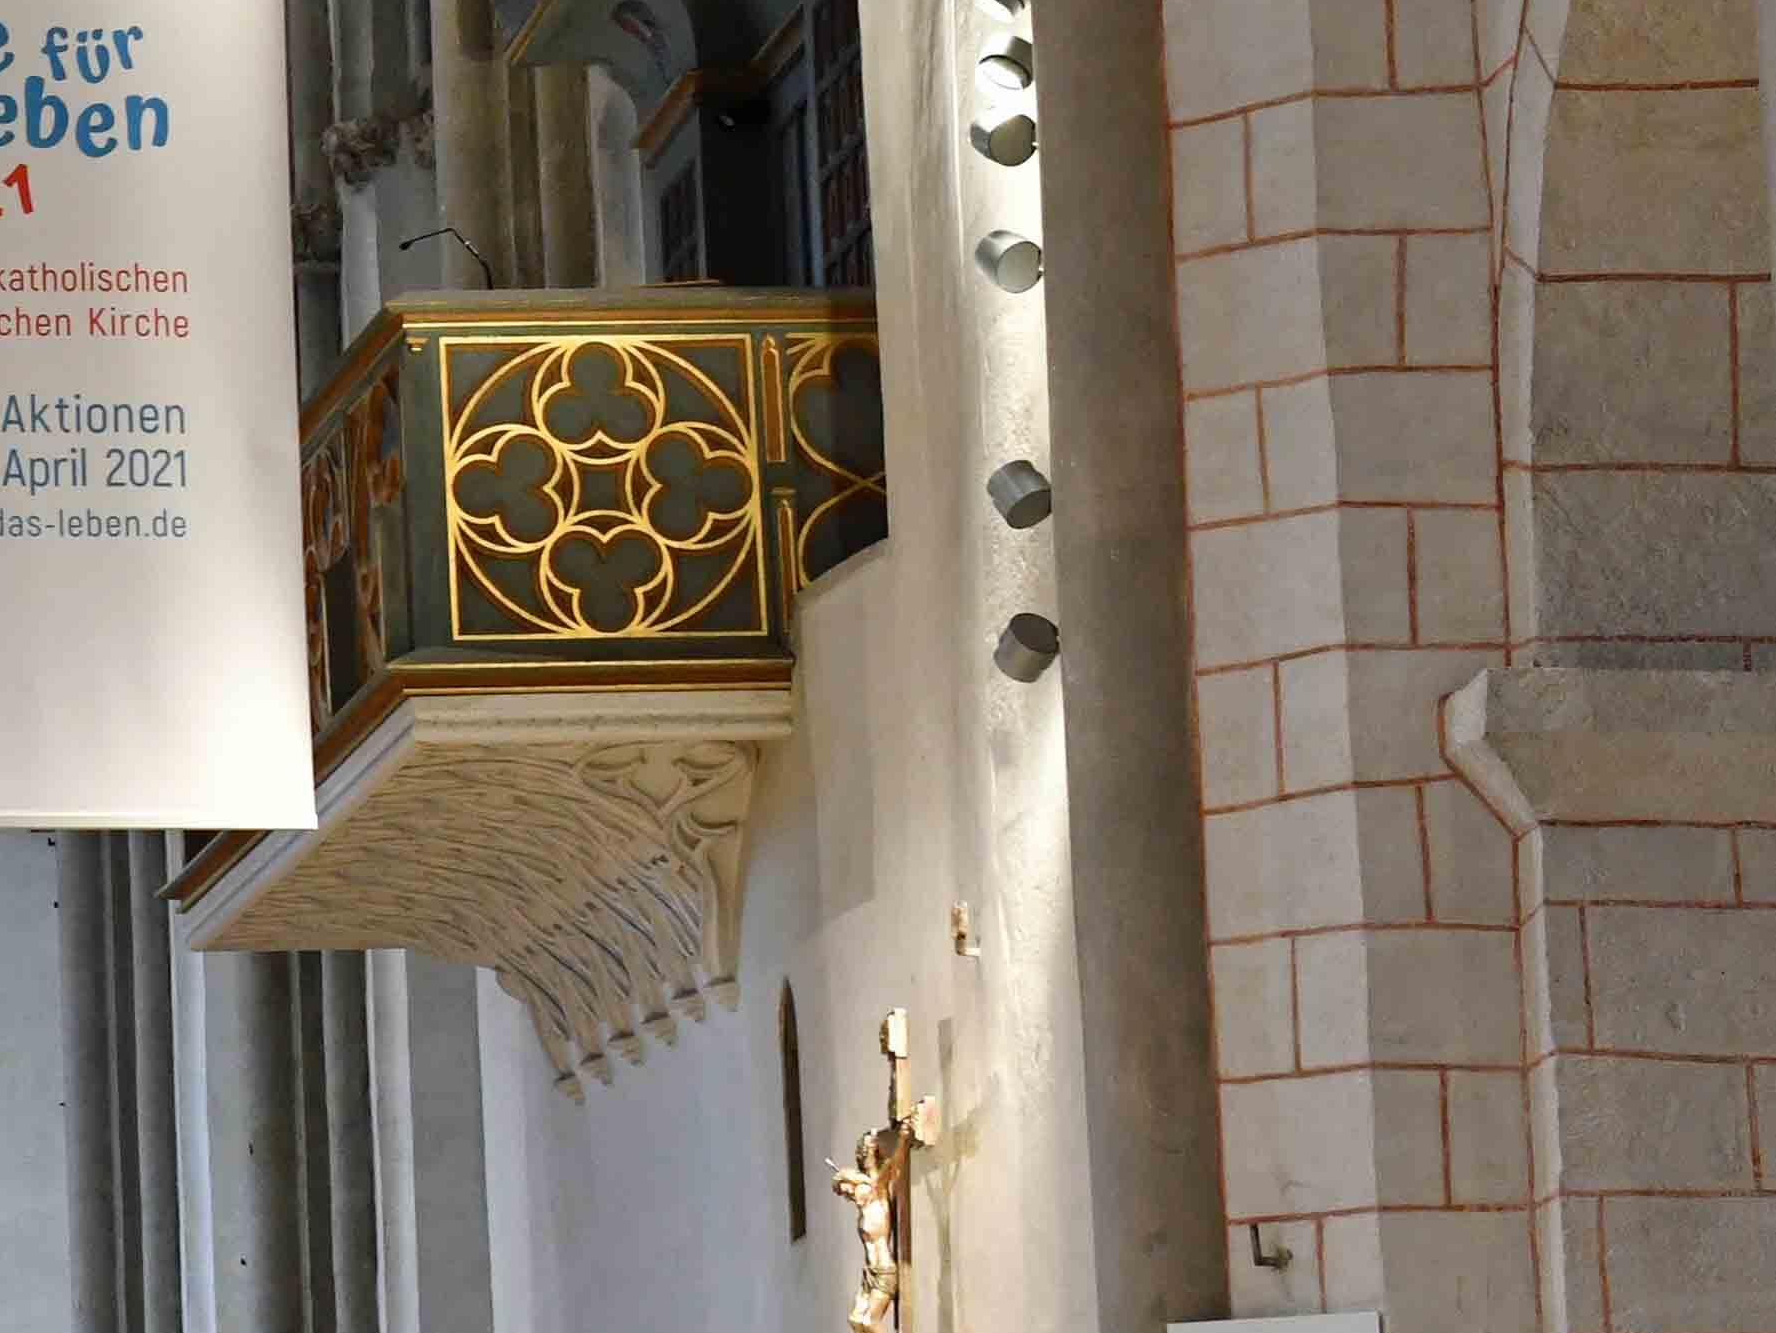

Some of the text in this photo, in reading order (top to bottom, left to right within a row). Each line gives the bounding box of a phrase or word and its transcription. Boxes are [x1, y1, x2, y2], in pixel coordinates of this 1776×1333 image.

[41, 25, 144, 84] für
[89, 307, 189, 338] Kirche
[2, 394, 185, 434] Aktionen
[2, 448, 87, 496] April
[106, 448, 186, 487] 2021
